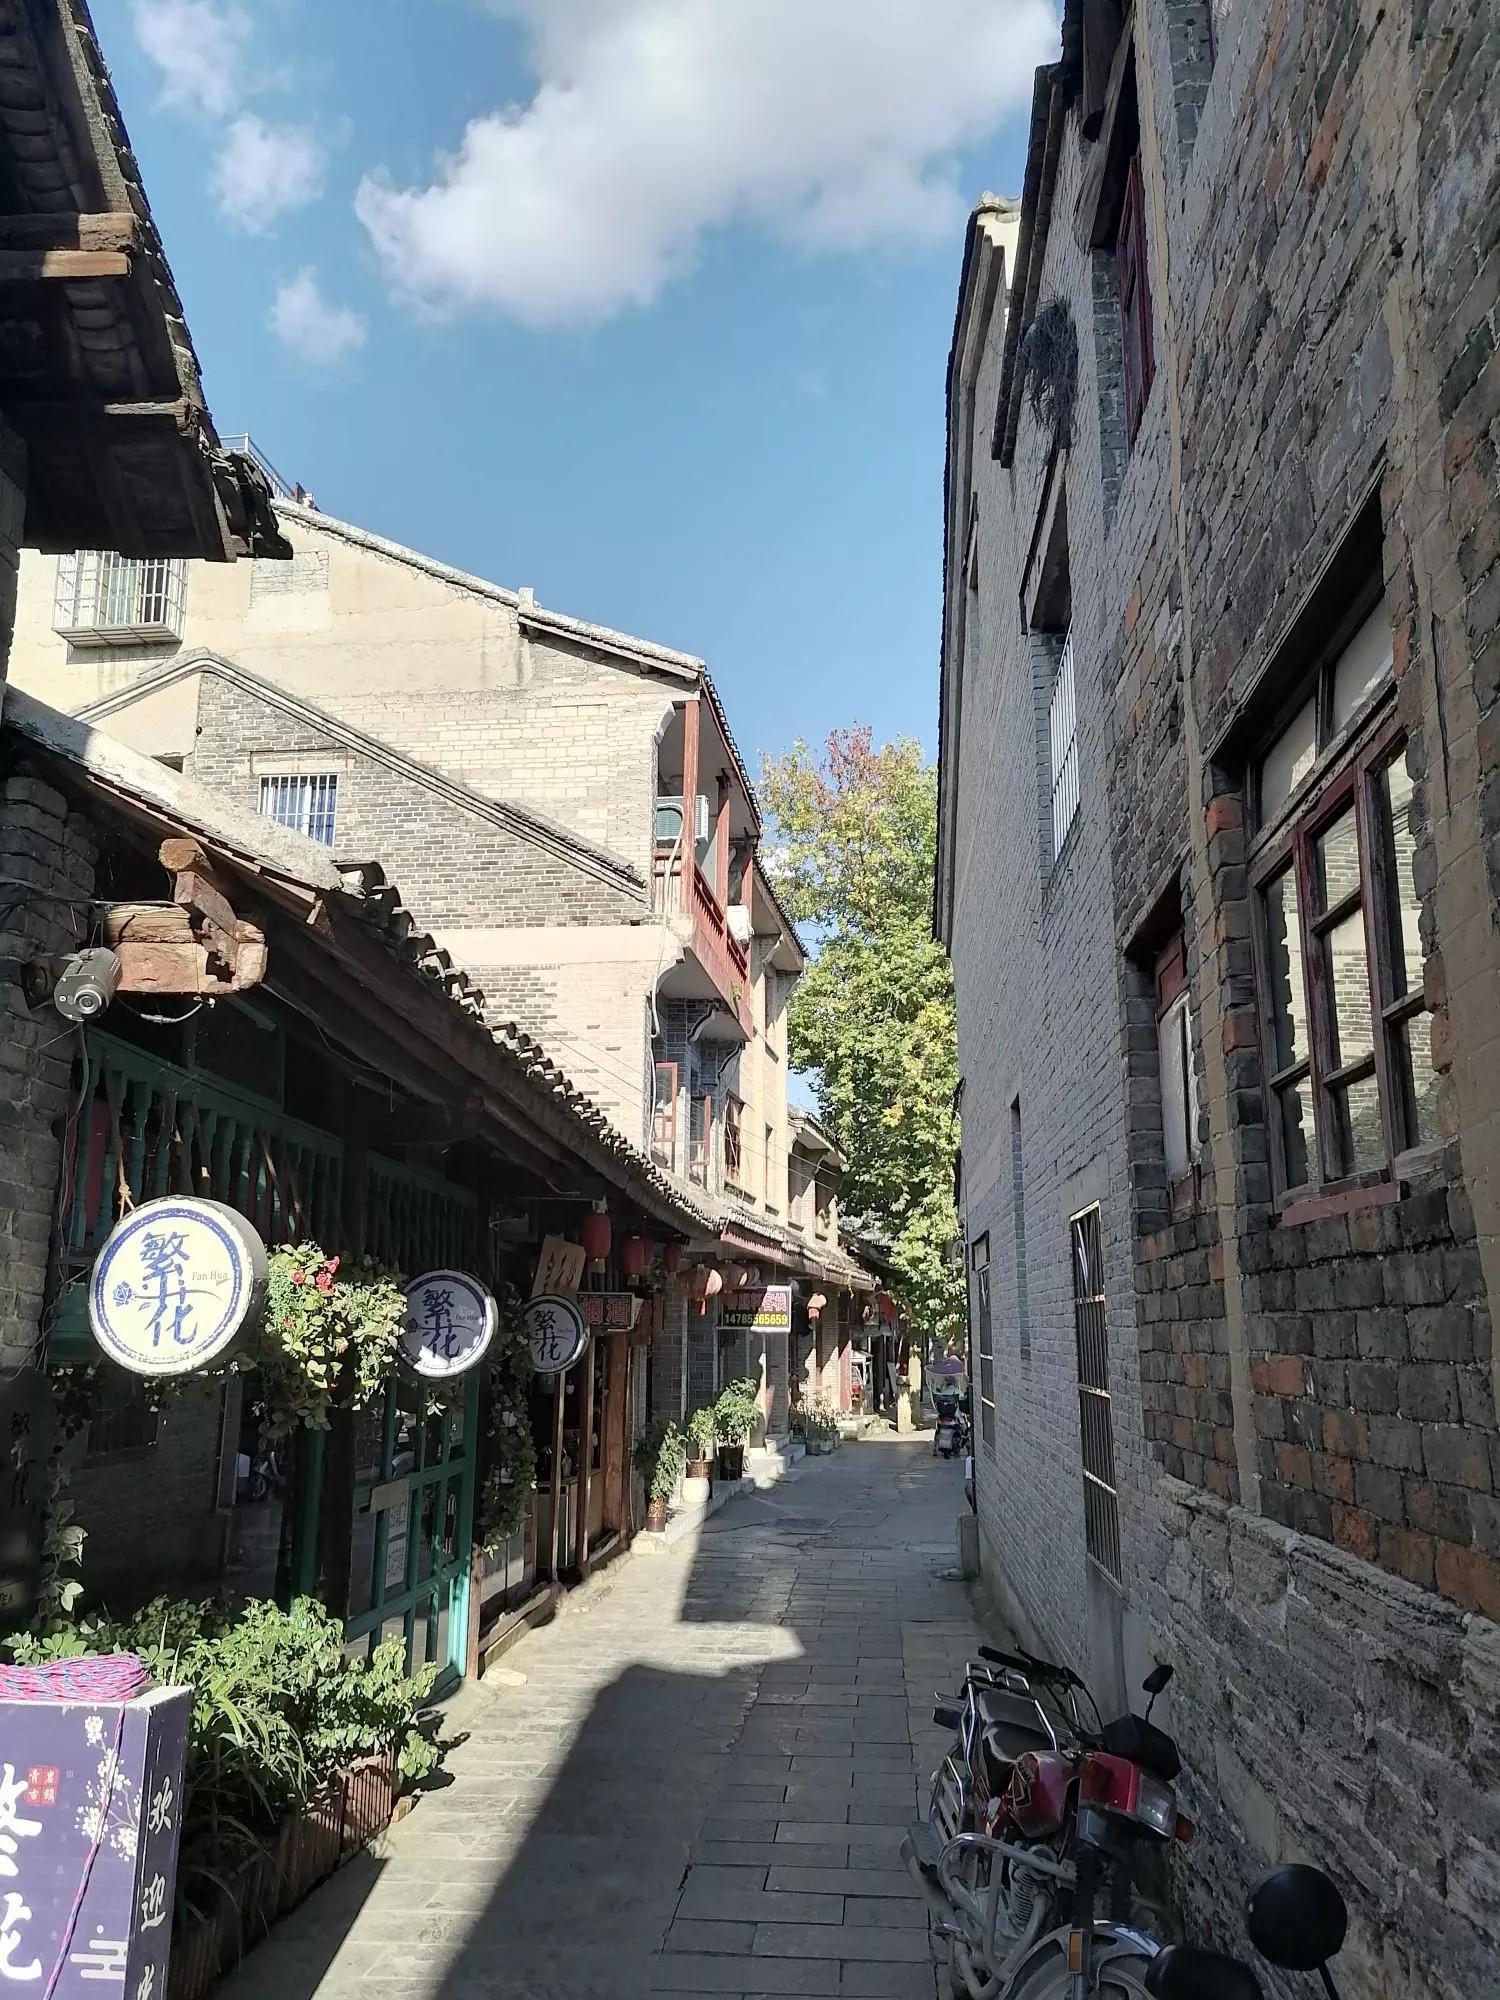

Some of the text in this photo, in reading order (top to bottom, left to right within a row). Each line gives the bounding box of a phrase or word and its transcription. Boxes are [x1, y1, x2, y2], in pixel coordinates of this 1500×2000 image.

[140, 1231, 198, 1347] 繁花
[192, 1270, 228, 1281] Fan Hua
[420, 1288, 460, 1359] 繁花
[533, 1309, 562, 1361] 繁花
[725, 1313, 788, 1325] 14785565659
